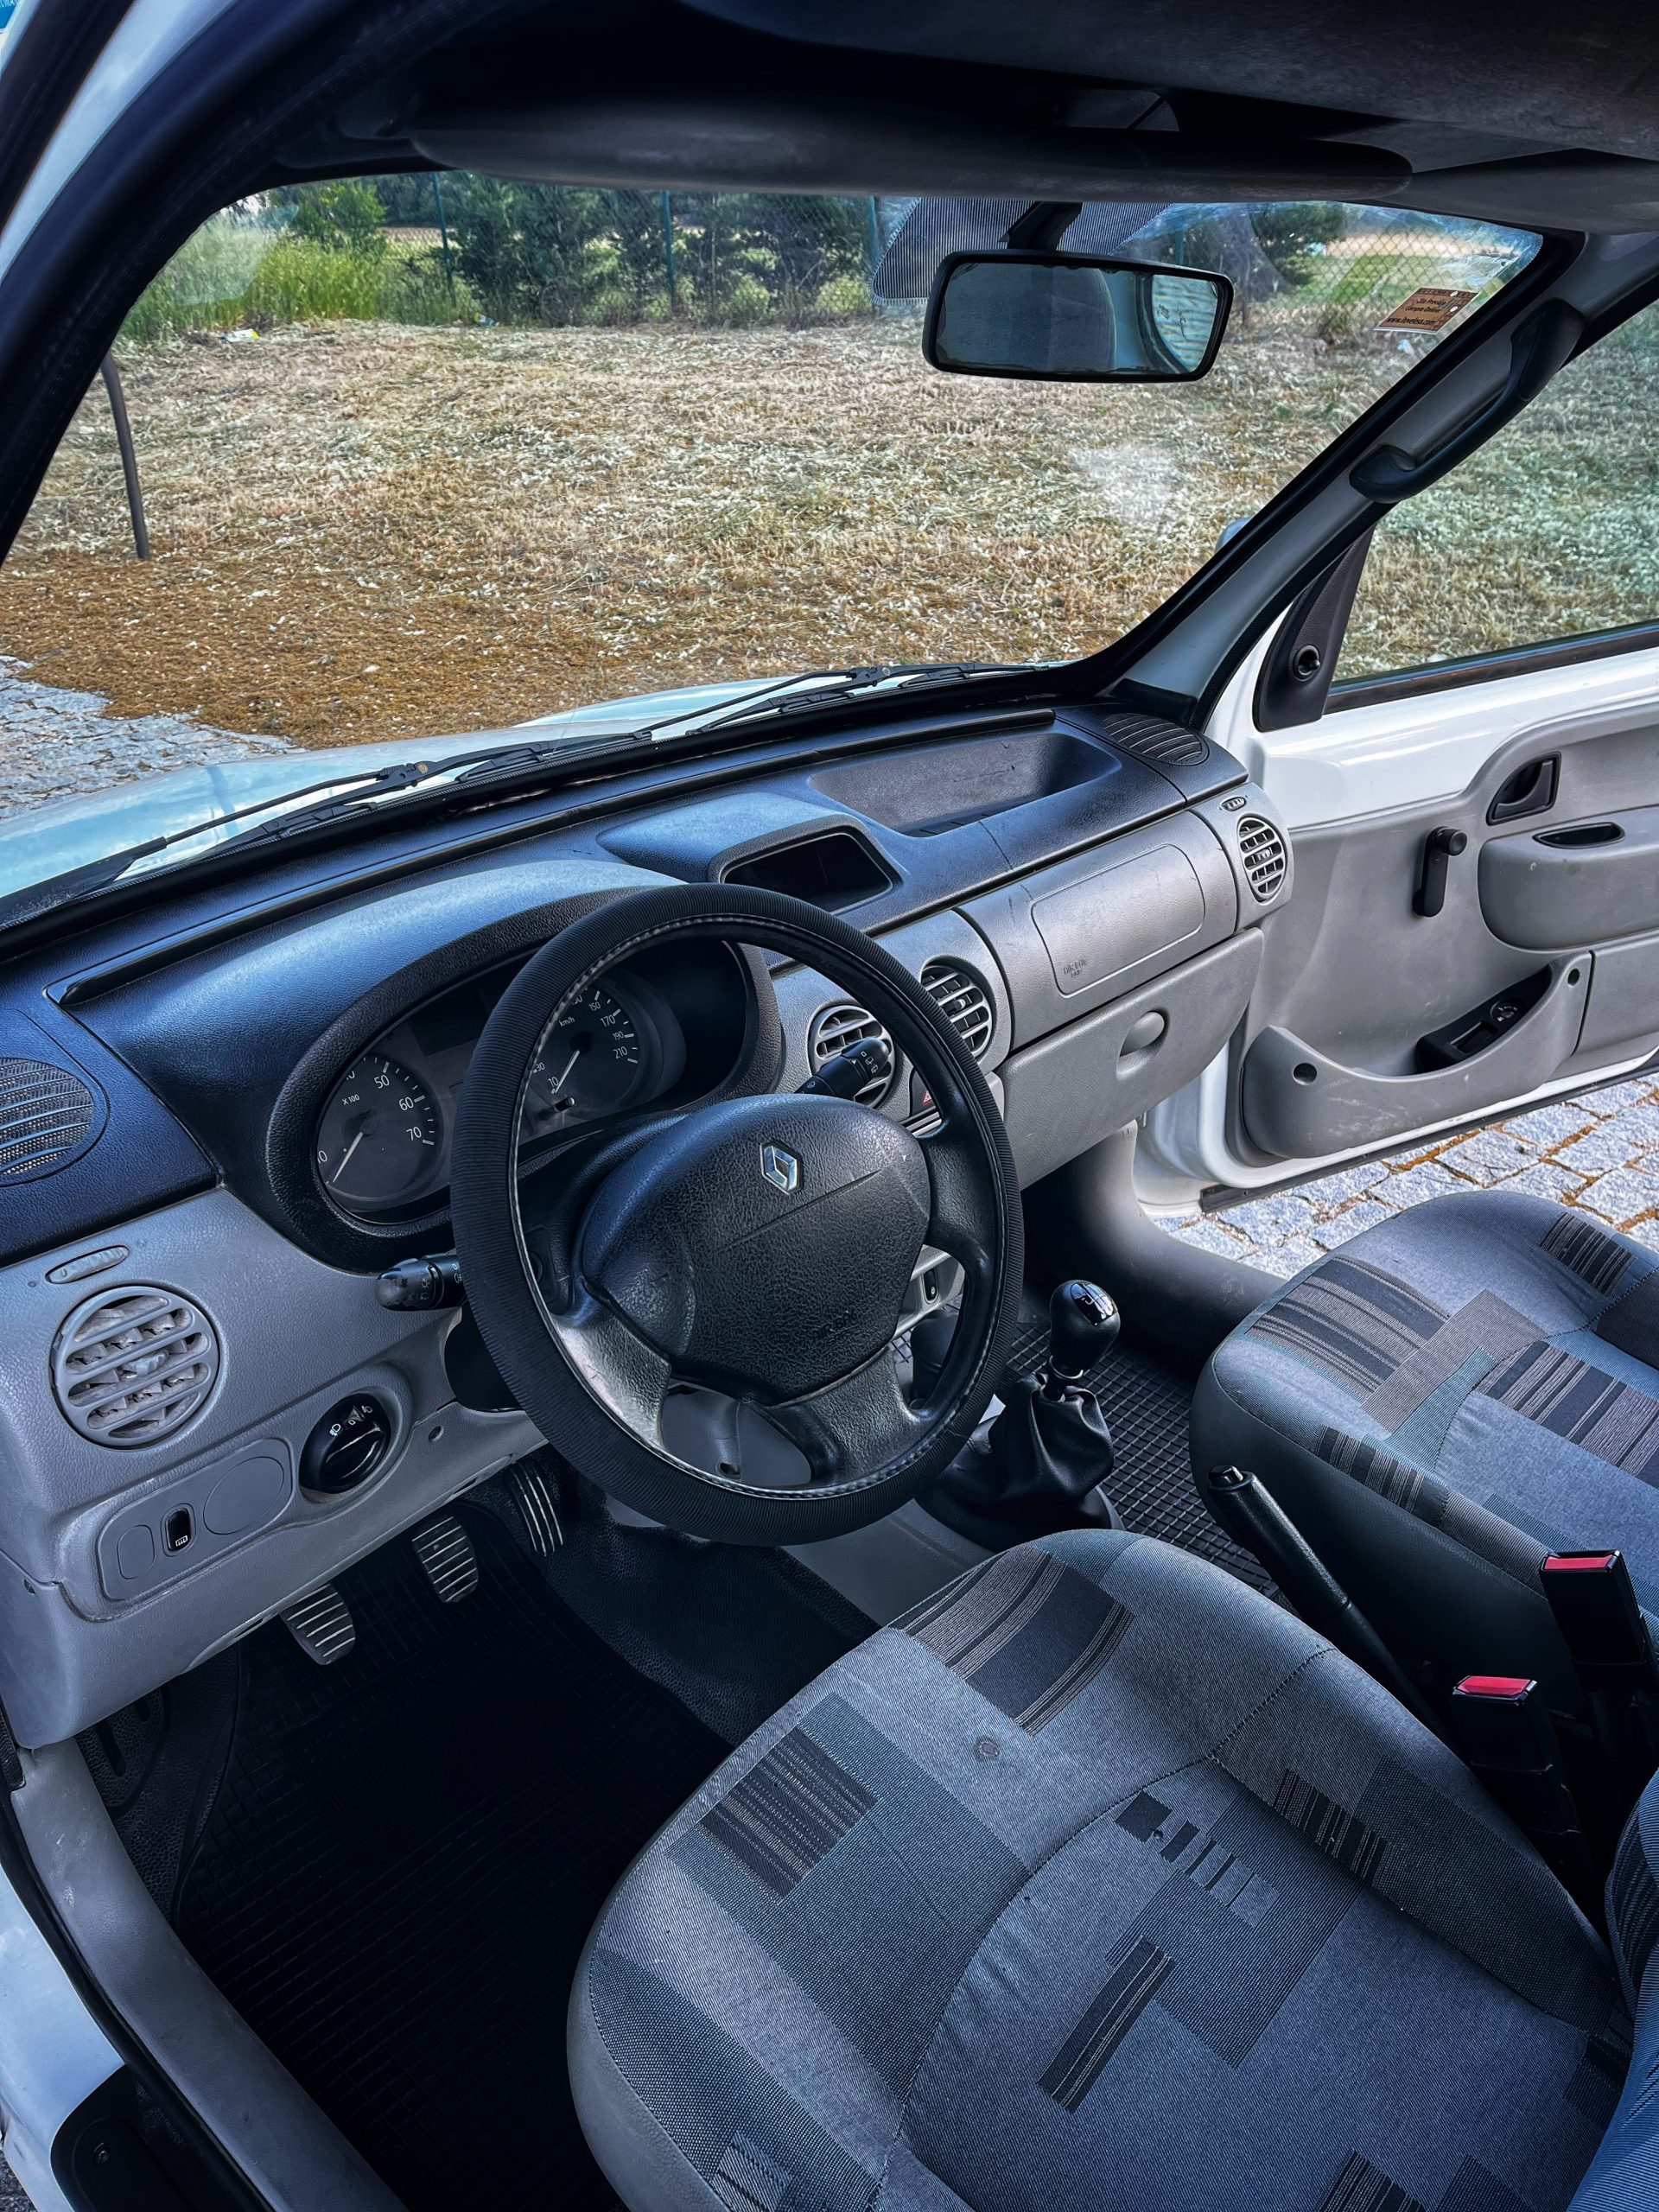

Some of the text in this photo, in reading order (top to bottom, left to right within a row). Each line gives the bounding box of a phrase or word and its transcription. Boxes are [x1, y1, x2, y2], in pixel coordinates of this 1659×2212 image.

[588, 1001, 602, 1012] 150
[558, 1016, 575, 1027] km/h
[601, 1014, 616, 1027] 170
[613, 1031, 624, 1041] 190
[613, 1046, 628, 1059] 210
[536, 1062, 545, 1071] 30
[373, 1074, 390, 1089] 50
[548, 1076, 559, 1088] 10
[398, 1096, 414, 1111] 60
[405, 1126, 422, 1141] 70
